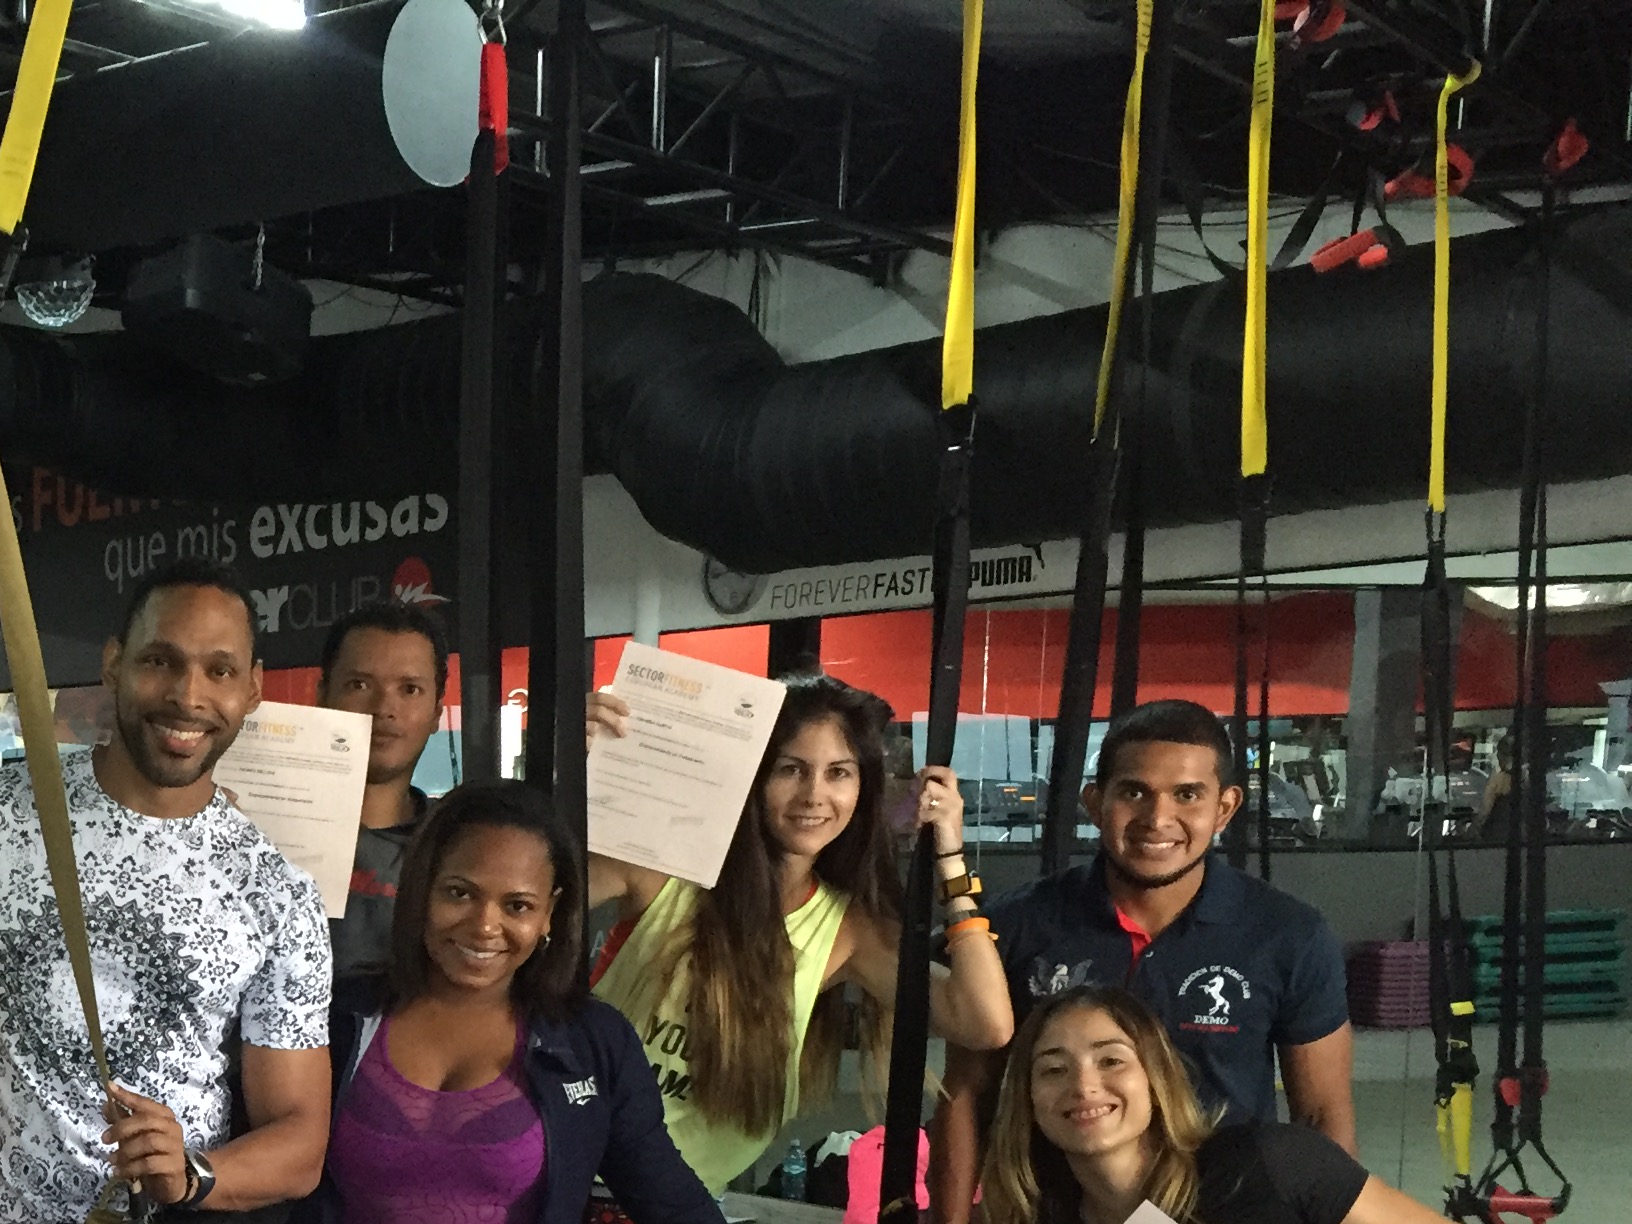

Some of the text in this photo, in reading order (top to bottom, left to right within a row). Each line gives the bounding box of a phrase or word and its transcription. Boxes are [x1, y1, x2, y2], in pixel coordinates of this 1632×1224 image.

[103, 528, 166, 594] que
[249, 492, 450, 559] excusas
[968, 556, 1033, 588] PUMA
[1193, 1014, 1230, 1025] DEMO
